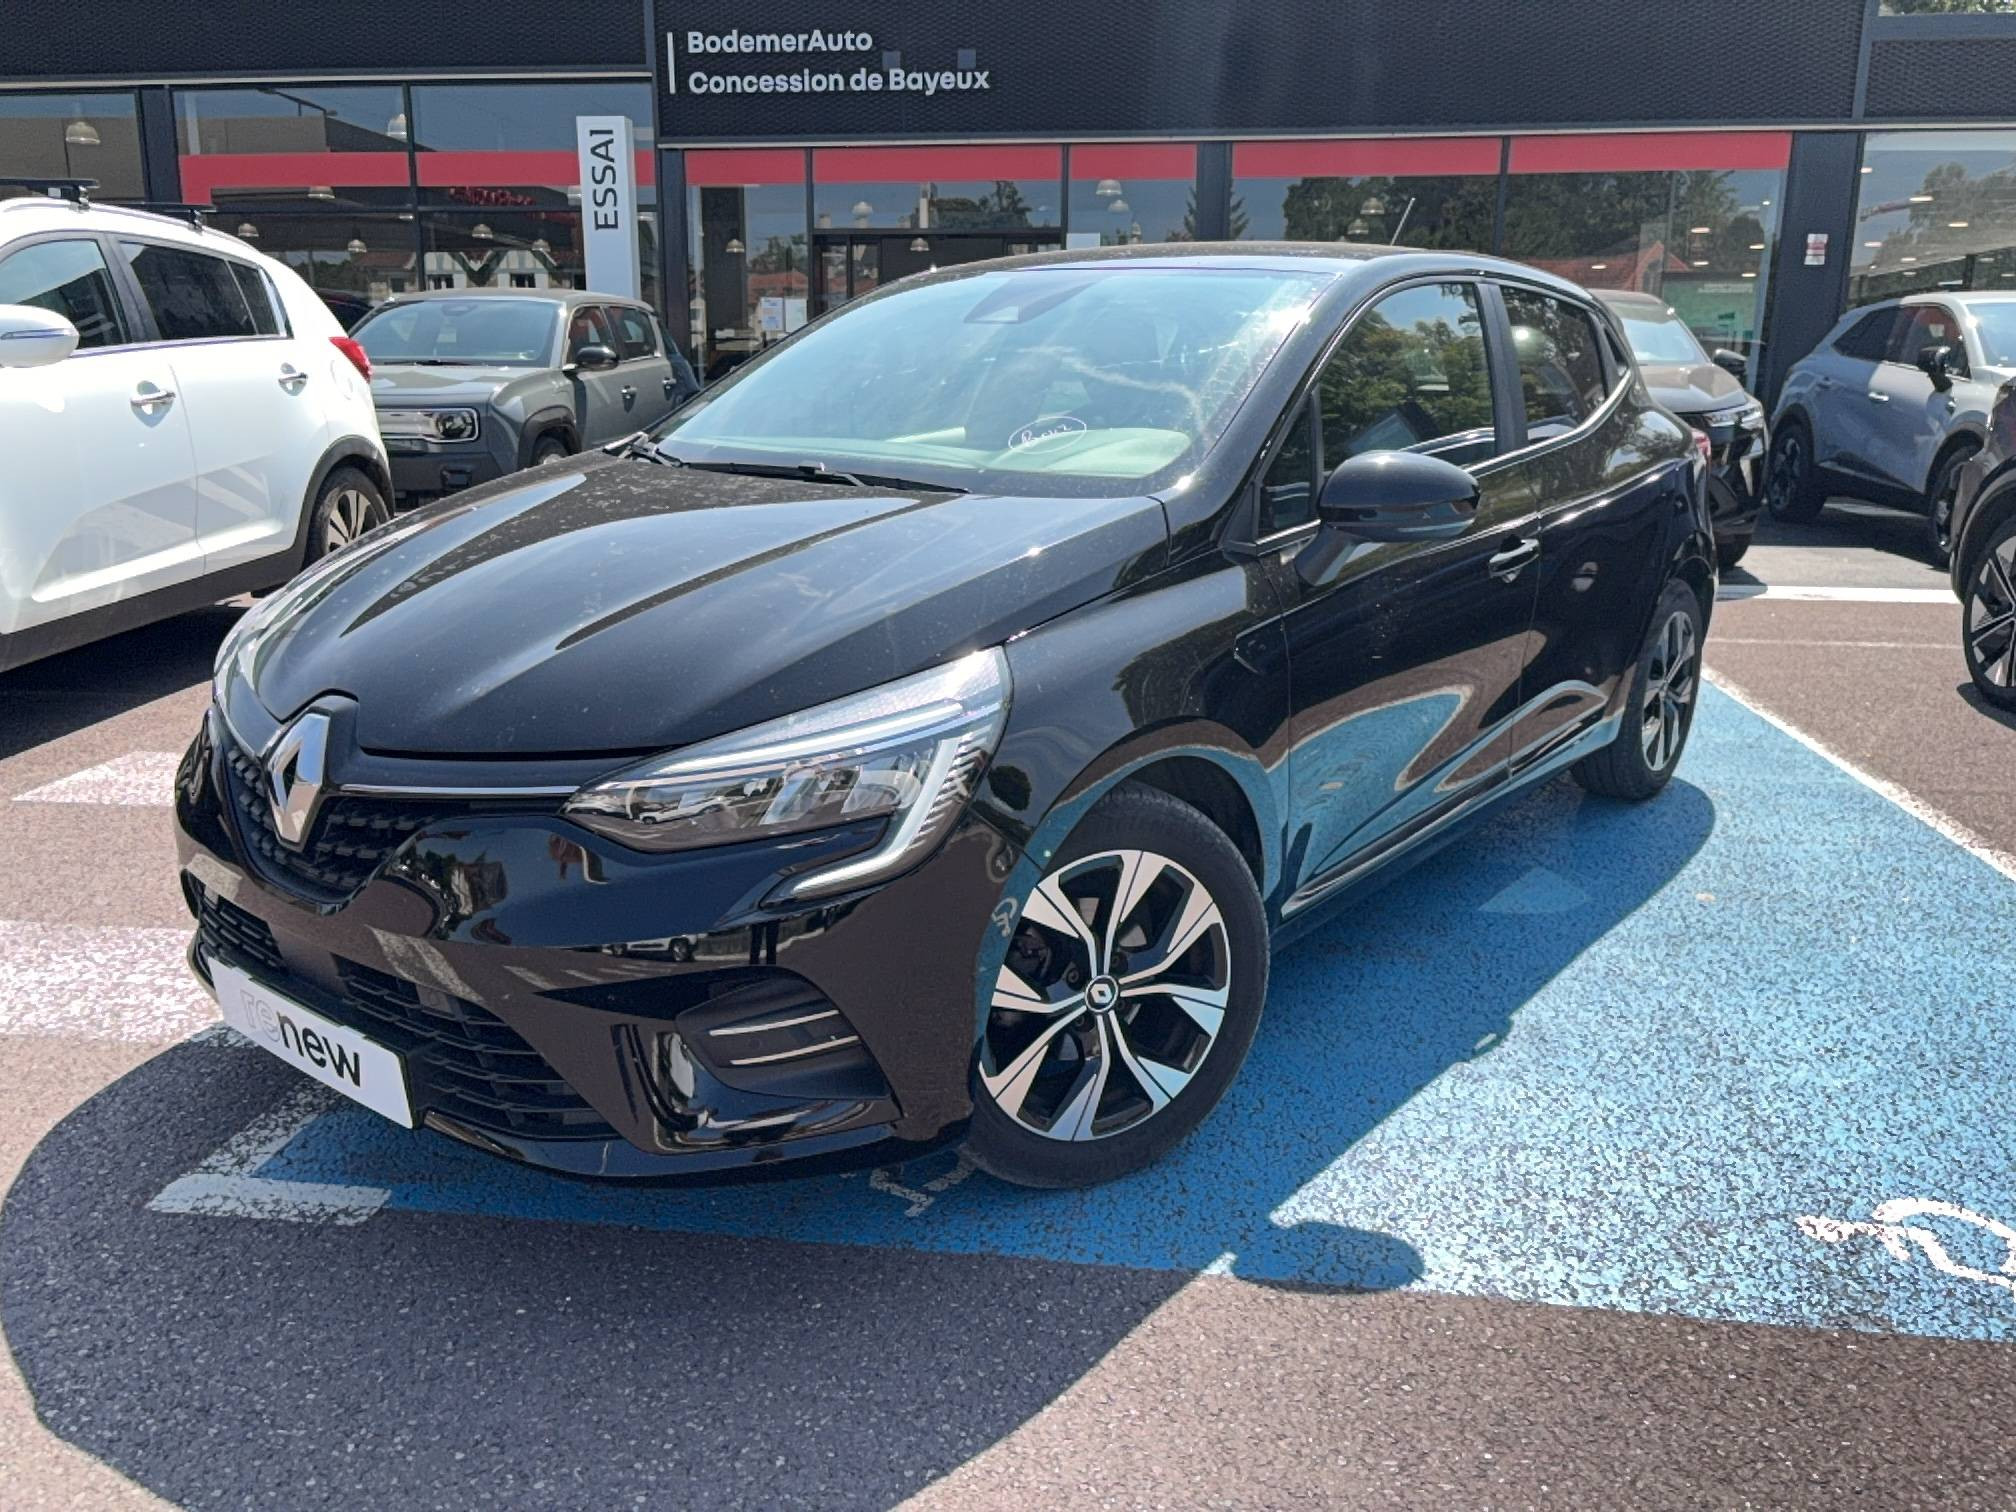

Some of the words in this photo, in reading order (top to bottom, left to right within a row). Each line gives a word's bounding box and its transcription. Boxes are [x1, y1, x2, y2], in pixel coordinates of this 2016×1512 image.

[687, 30, 873, 54] BodemerAuto
[688, 68, 845, 94] Concession
[850, 68, 883, 91] de
[889, 68, 990, 96] Bayeux
[589, 129, 619, 230] ESSAI
[240, 989, 361, 1087] renew
